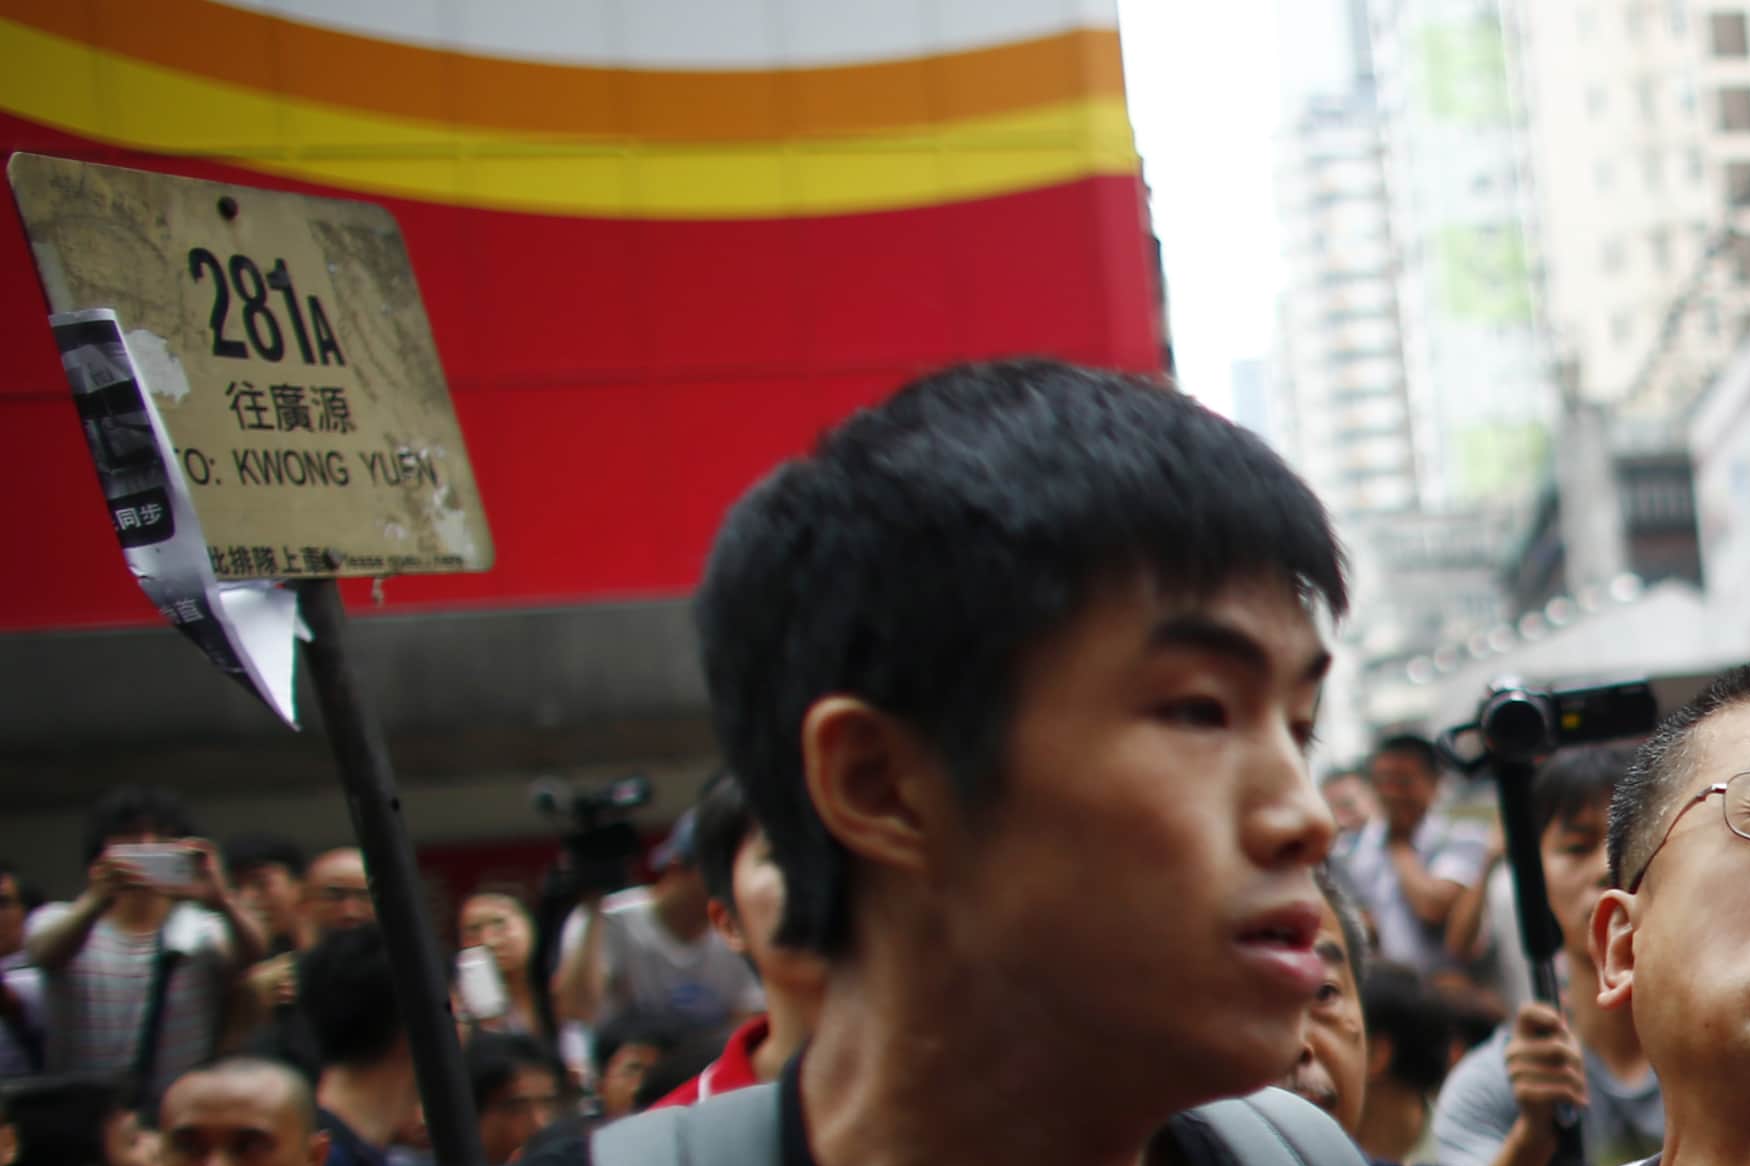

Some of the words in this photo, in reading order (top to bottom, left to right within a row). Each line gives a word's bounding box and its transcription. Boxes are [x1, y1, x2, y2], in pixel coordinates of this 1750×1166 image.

[187, 247, 346, 367] 281A
[225, 381, 357, 434] 往廣源
[176, 448, 223, 487] O:
[233, 450, 350, 488] KWONG
